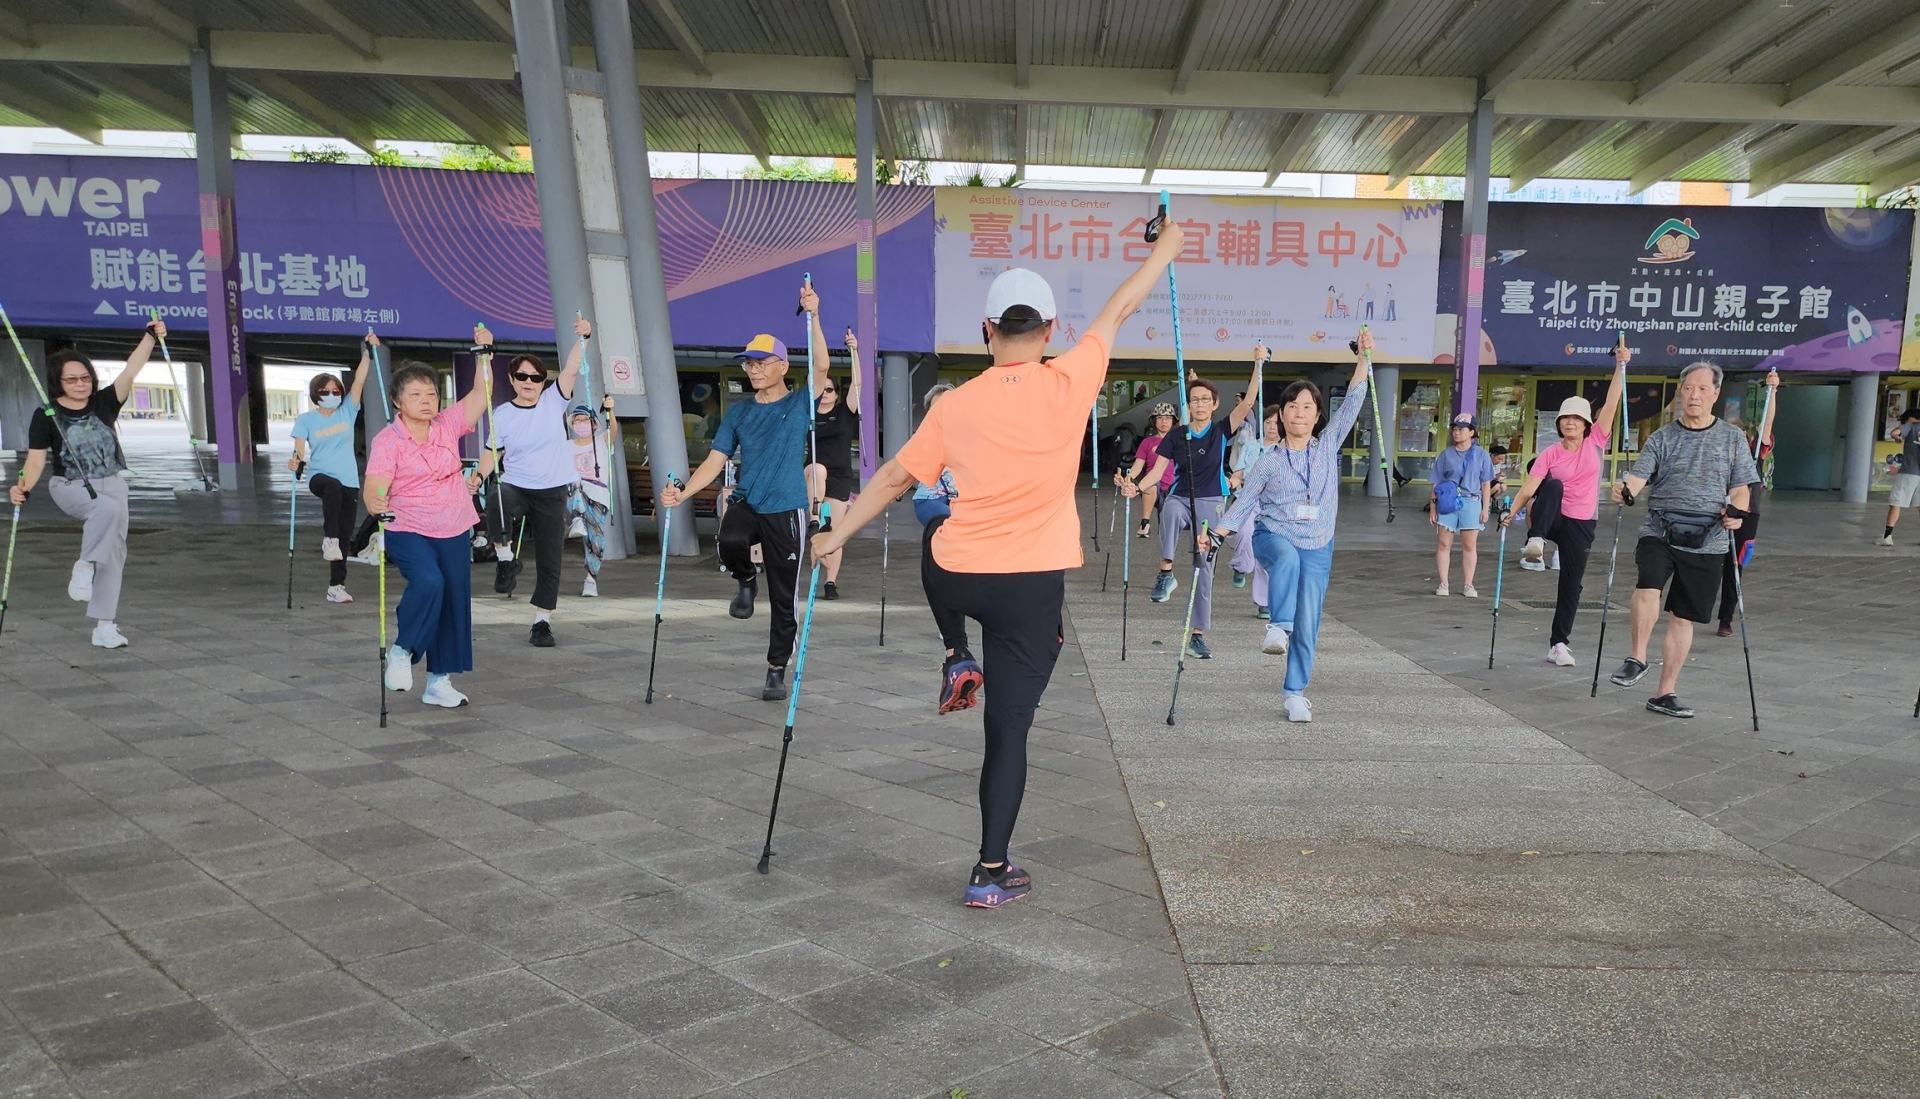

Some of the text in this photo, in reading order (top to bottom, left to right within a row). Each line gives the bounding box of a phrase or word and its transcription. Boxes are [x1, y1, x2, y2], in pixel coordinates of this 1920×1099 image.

[970, 195, 1112, 209] Assistive Device Center
[84, 221, 149, 237] TAIPEI
[969, 211, 1408, 268] 臺北市合宜輔具中心
[1501, 279, 1832, 318] 臺北市中山親子館
[125, 300, 208, 320] Empowe
[1538, 317, 1798, 334] Taipei city Zhongshan parent-child center
